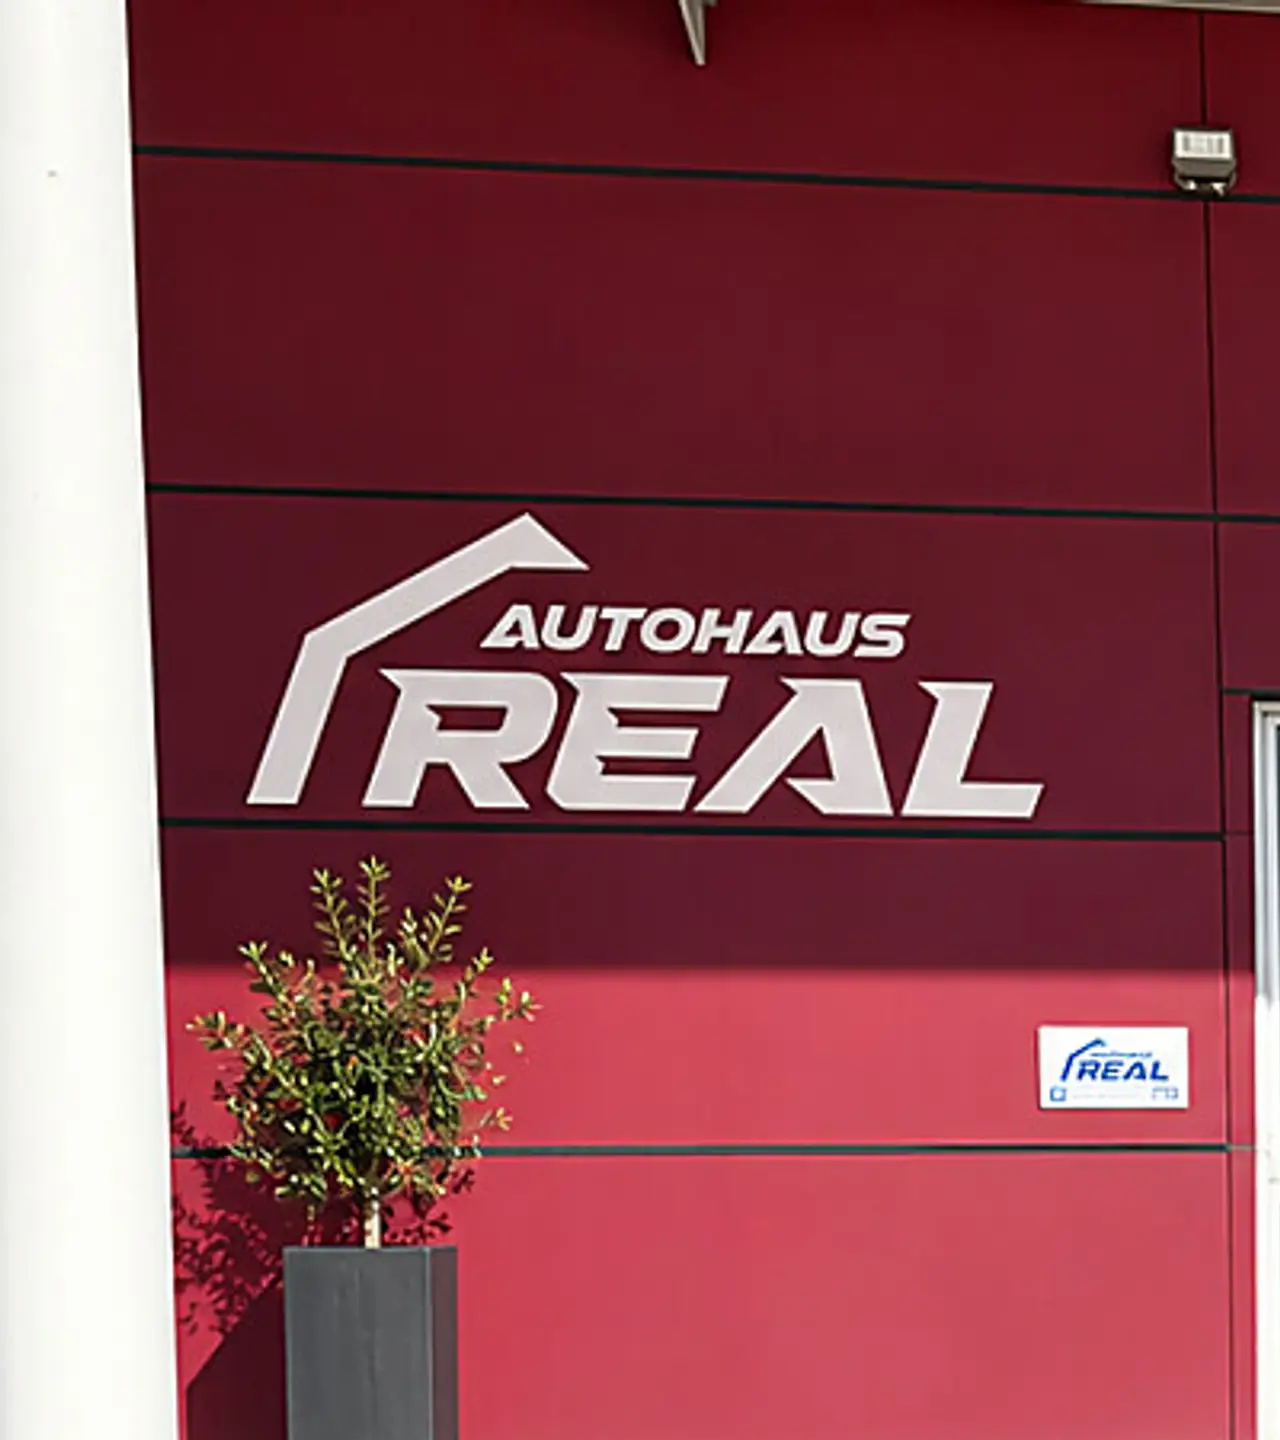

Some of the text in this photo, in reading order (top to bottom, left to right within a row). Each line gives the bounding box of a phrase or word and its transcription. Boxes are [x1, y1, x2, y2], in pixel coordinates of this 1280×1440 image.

[480, 604, 912, 658] AUTOHAUS
[361, 668, 1045, 819] REAL
[1077, 1059, 1170, 1081] REAL
